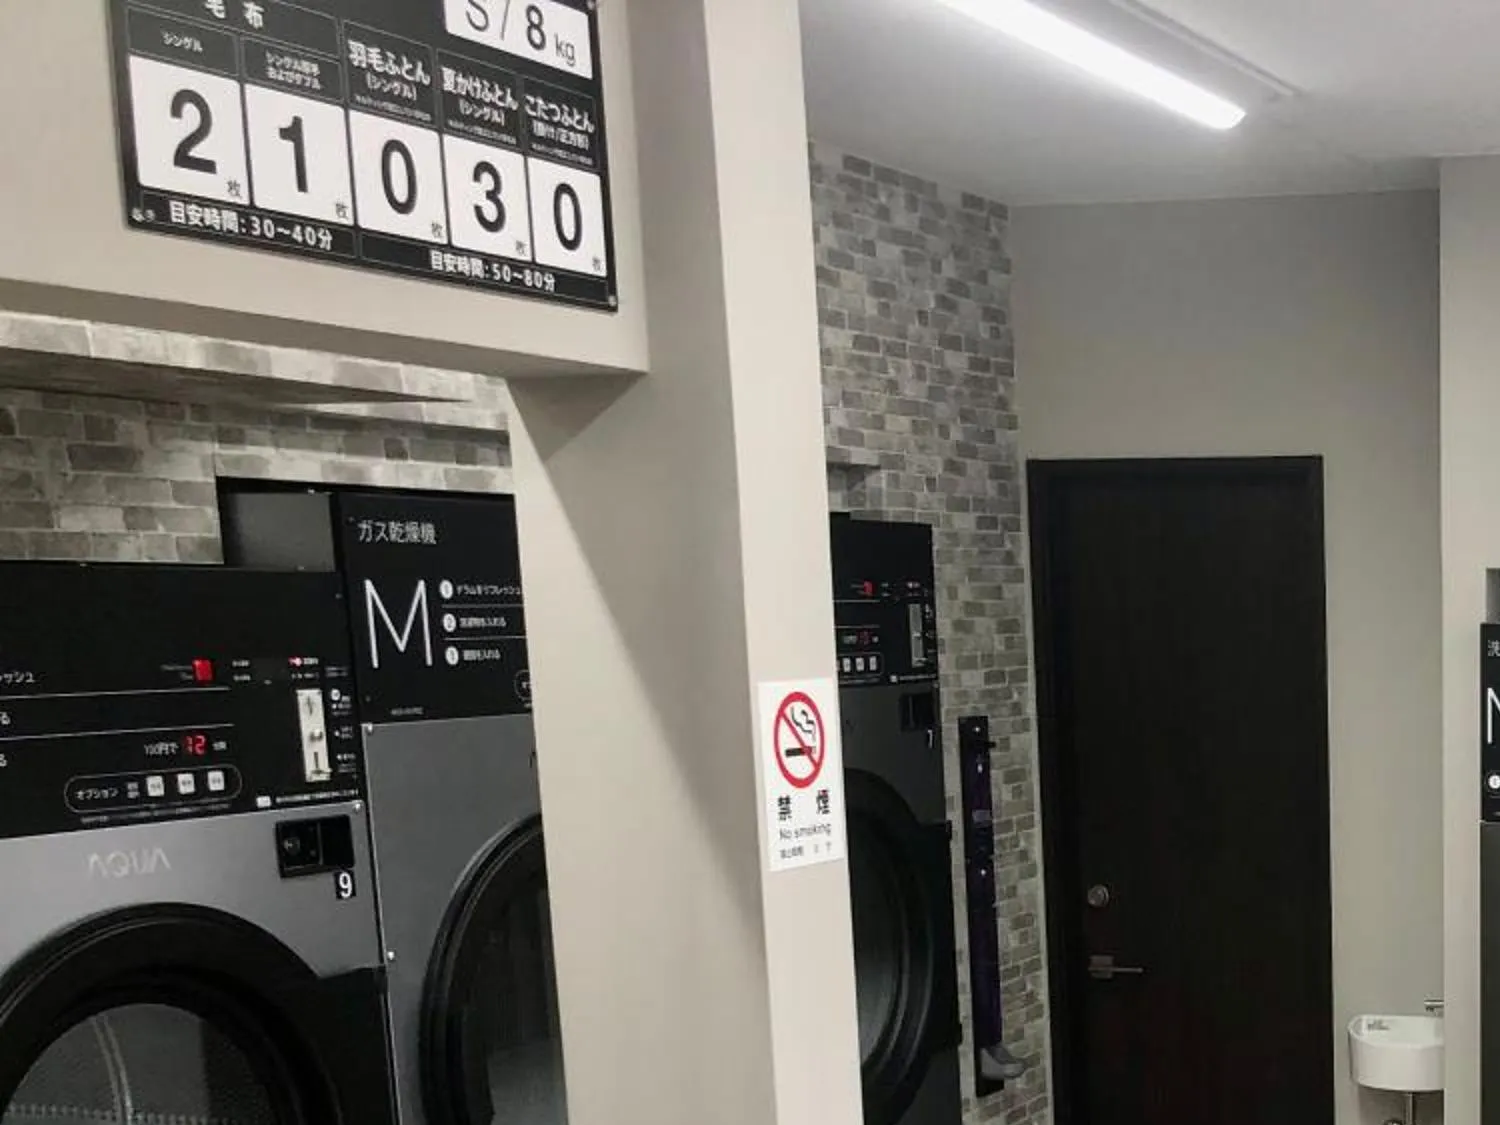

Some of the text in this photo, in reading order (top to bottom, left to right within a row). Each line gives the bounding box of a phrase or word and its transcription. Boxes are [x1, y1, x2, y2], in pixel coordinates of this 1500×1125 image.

[348, 39, 431, 86] 羽毛ふとん
[170, 89, 218, 175] 2
[524, 95, 595, 133] こたつふとん
[278, 115, 309, 193] 1
[381, 139, 418, 215] 0
[472, 160, 507, 233] 3
[553, 182, 583, 251] 0
[357, 520, 437, 545] ガス乾燥機
[364, 579, 433, 669] M
[338, 873, 353, 897] 9
